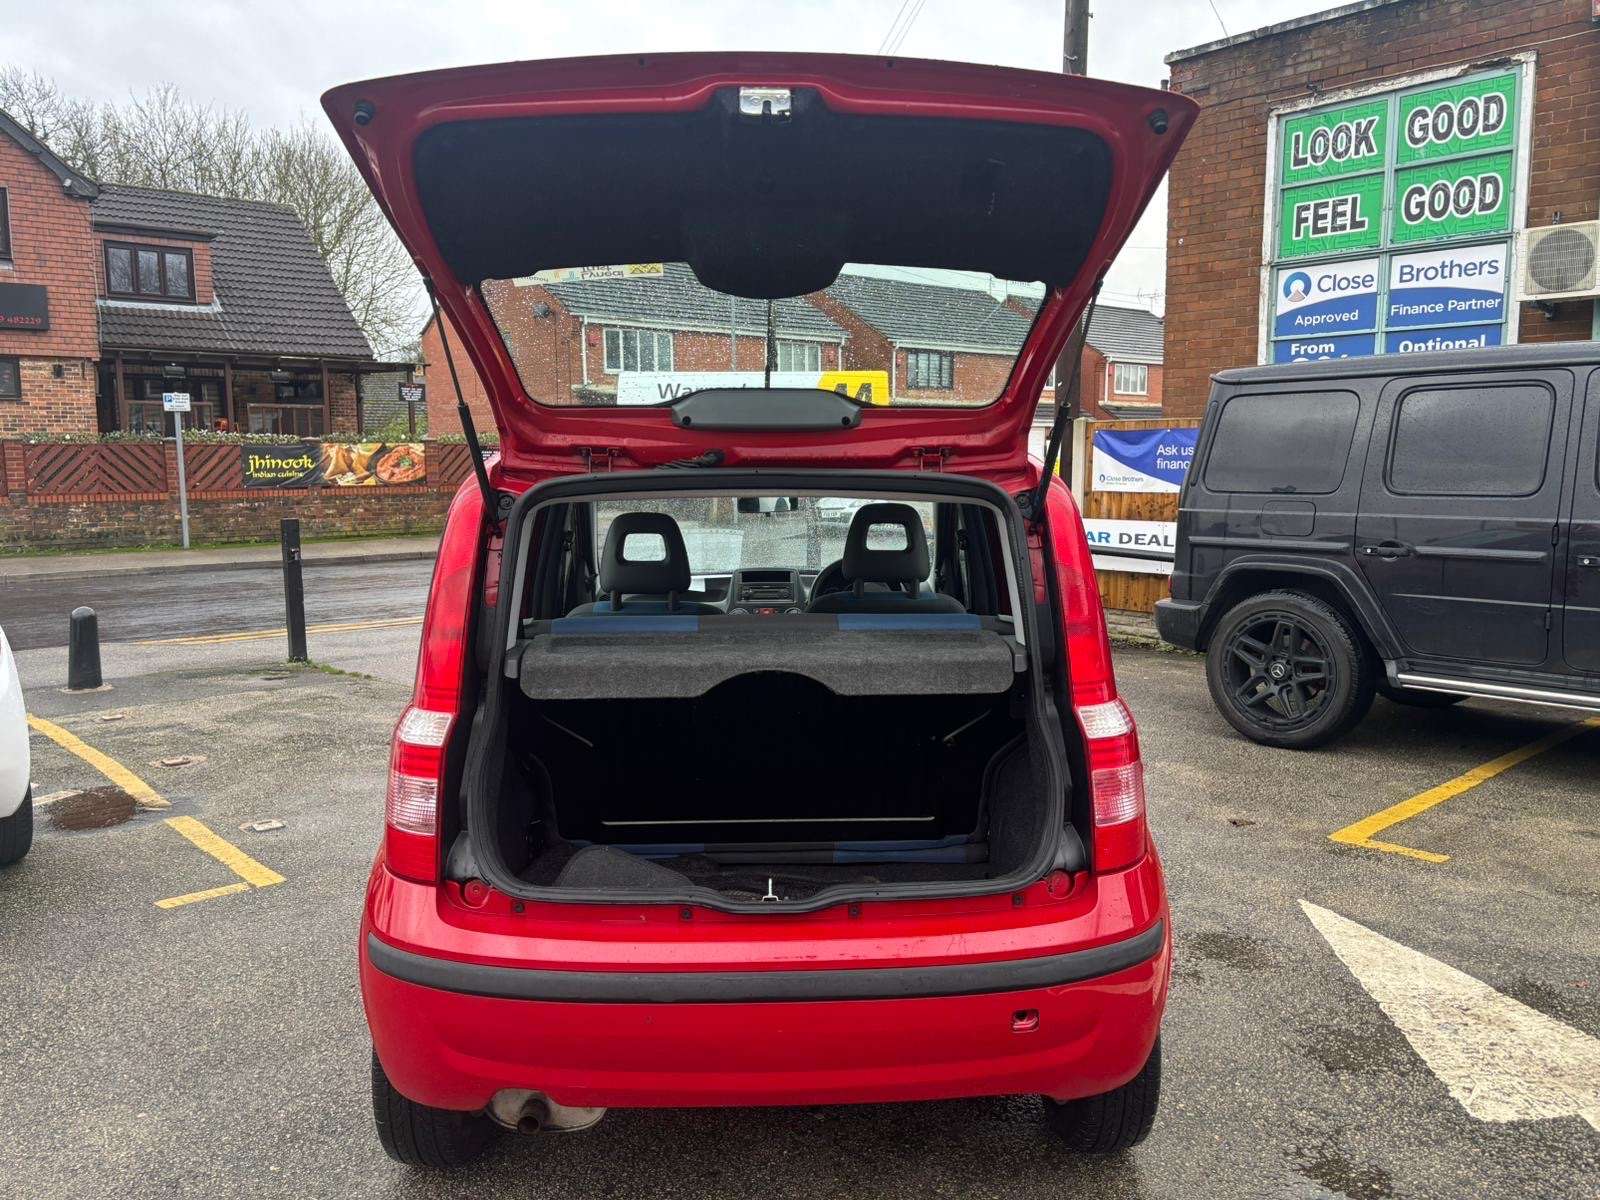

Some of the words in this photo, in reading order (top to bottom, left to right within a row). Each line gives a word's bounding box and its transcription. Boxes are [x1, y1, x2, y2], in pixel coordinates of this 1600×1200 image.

[1292, 116, 1379, 169] LOOK
[1405, 92, 1507, 147] GOOD
[1294, 195, 1367, 239] FEEL
[1402, 173, 1503, 224] GOOD
[1317, 273, 1375, 293] Close
[1399, 259, 1499, 284] Brothers
[1294, 310, 1359, 327] Approved
[1391, 303, 1444, 317] Finance
[1448, 297, 1502, 312] Partner
[1290, 342, 1335, 356] From
[1156, 444, 1179, 456] Ask
[1181, 446, 1194, 456] us
[245, 454, 316, 475] jhinook
[1156, 457, 1191, 470] financ
[1086, 530, 1111, 544] AR
[1118, 532, 1175, 547] DEAL
